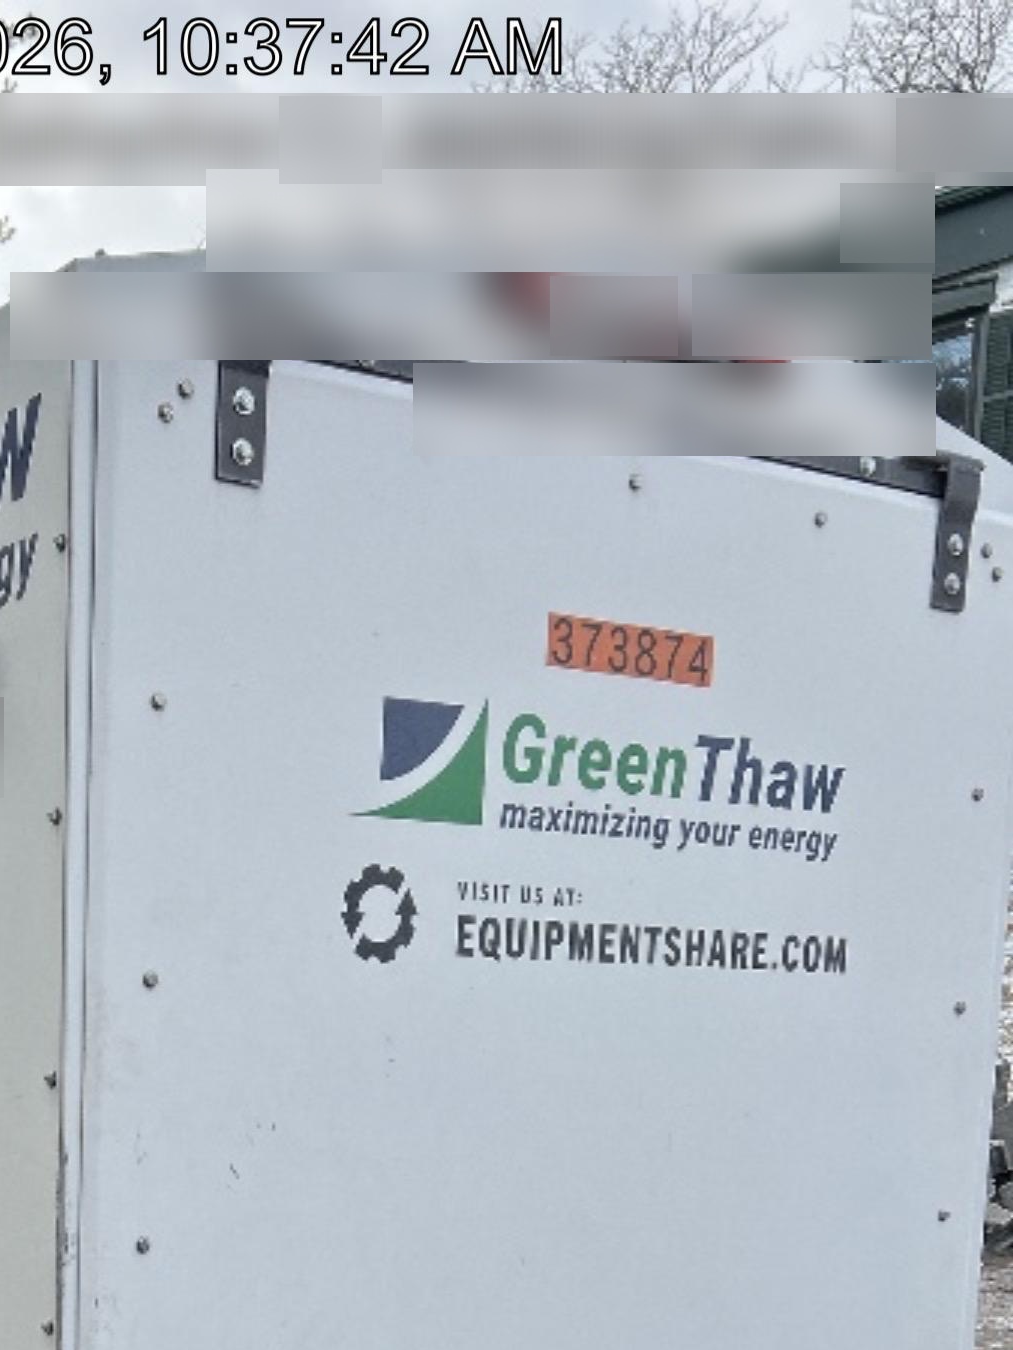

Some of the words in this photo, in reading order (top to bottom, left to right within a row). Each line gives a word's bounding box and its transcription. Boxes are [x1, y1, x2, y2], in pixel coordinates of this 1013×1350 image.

[550, 617, 710, 682] 373874
[499, 800, 670, 849] maximizing
[676, 818, 742, 851] your
[747, 826, 838, 863] energy
[457, 880, 510, 904] VISIT
[520, 886, 544, 906] US
[553, 887, 584, 907] AT:
[456, 914, 848, 974] EQUIPMENTSHARE.COM
